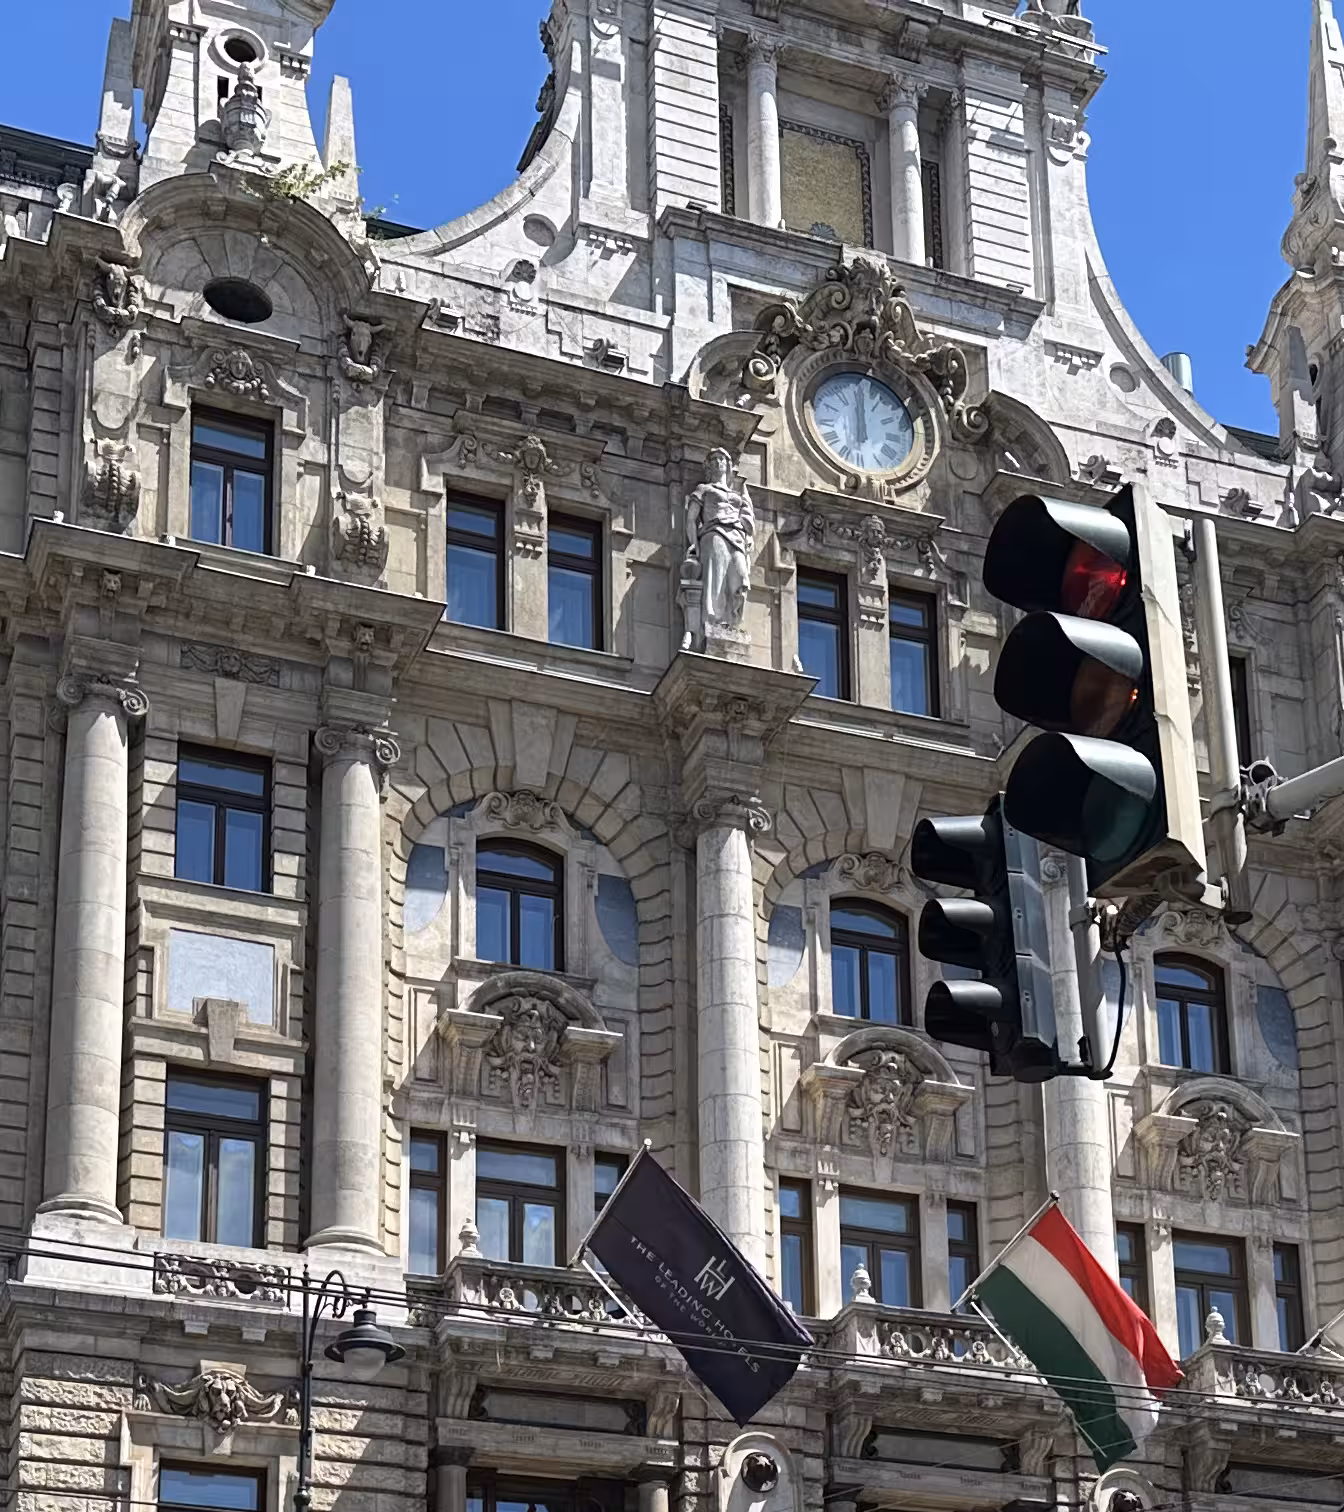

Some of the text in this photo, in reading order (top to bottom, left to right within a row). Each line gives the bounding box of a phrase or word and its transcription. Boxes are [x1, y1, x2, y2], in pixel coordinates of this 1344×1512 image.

[630, 1236, 761, 1373] THE LEADING HOELS
